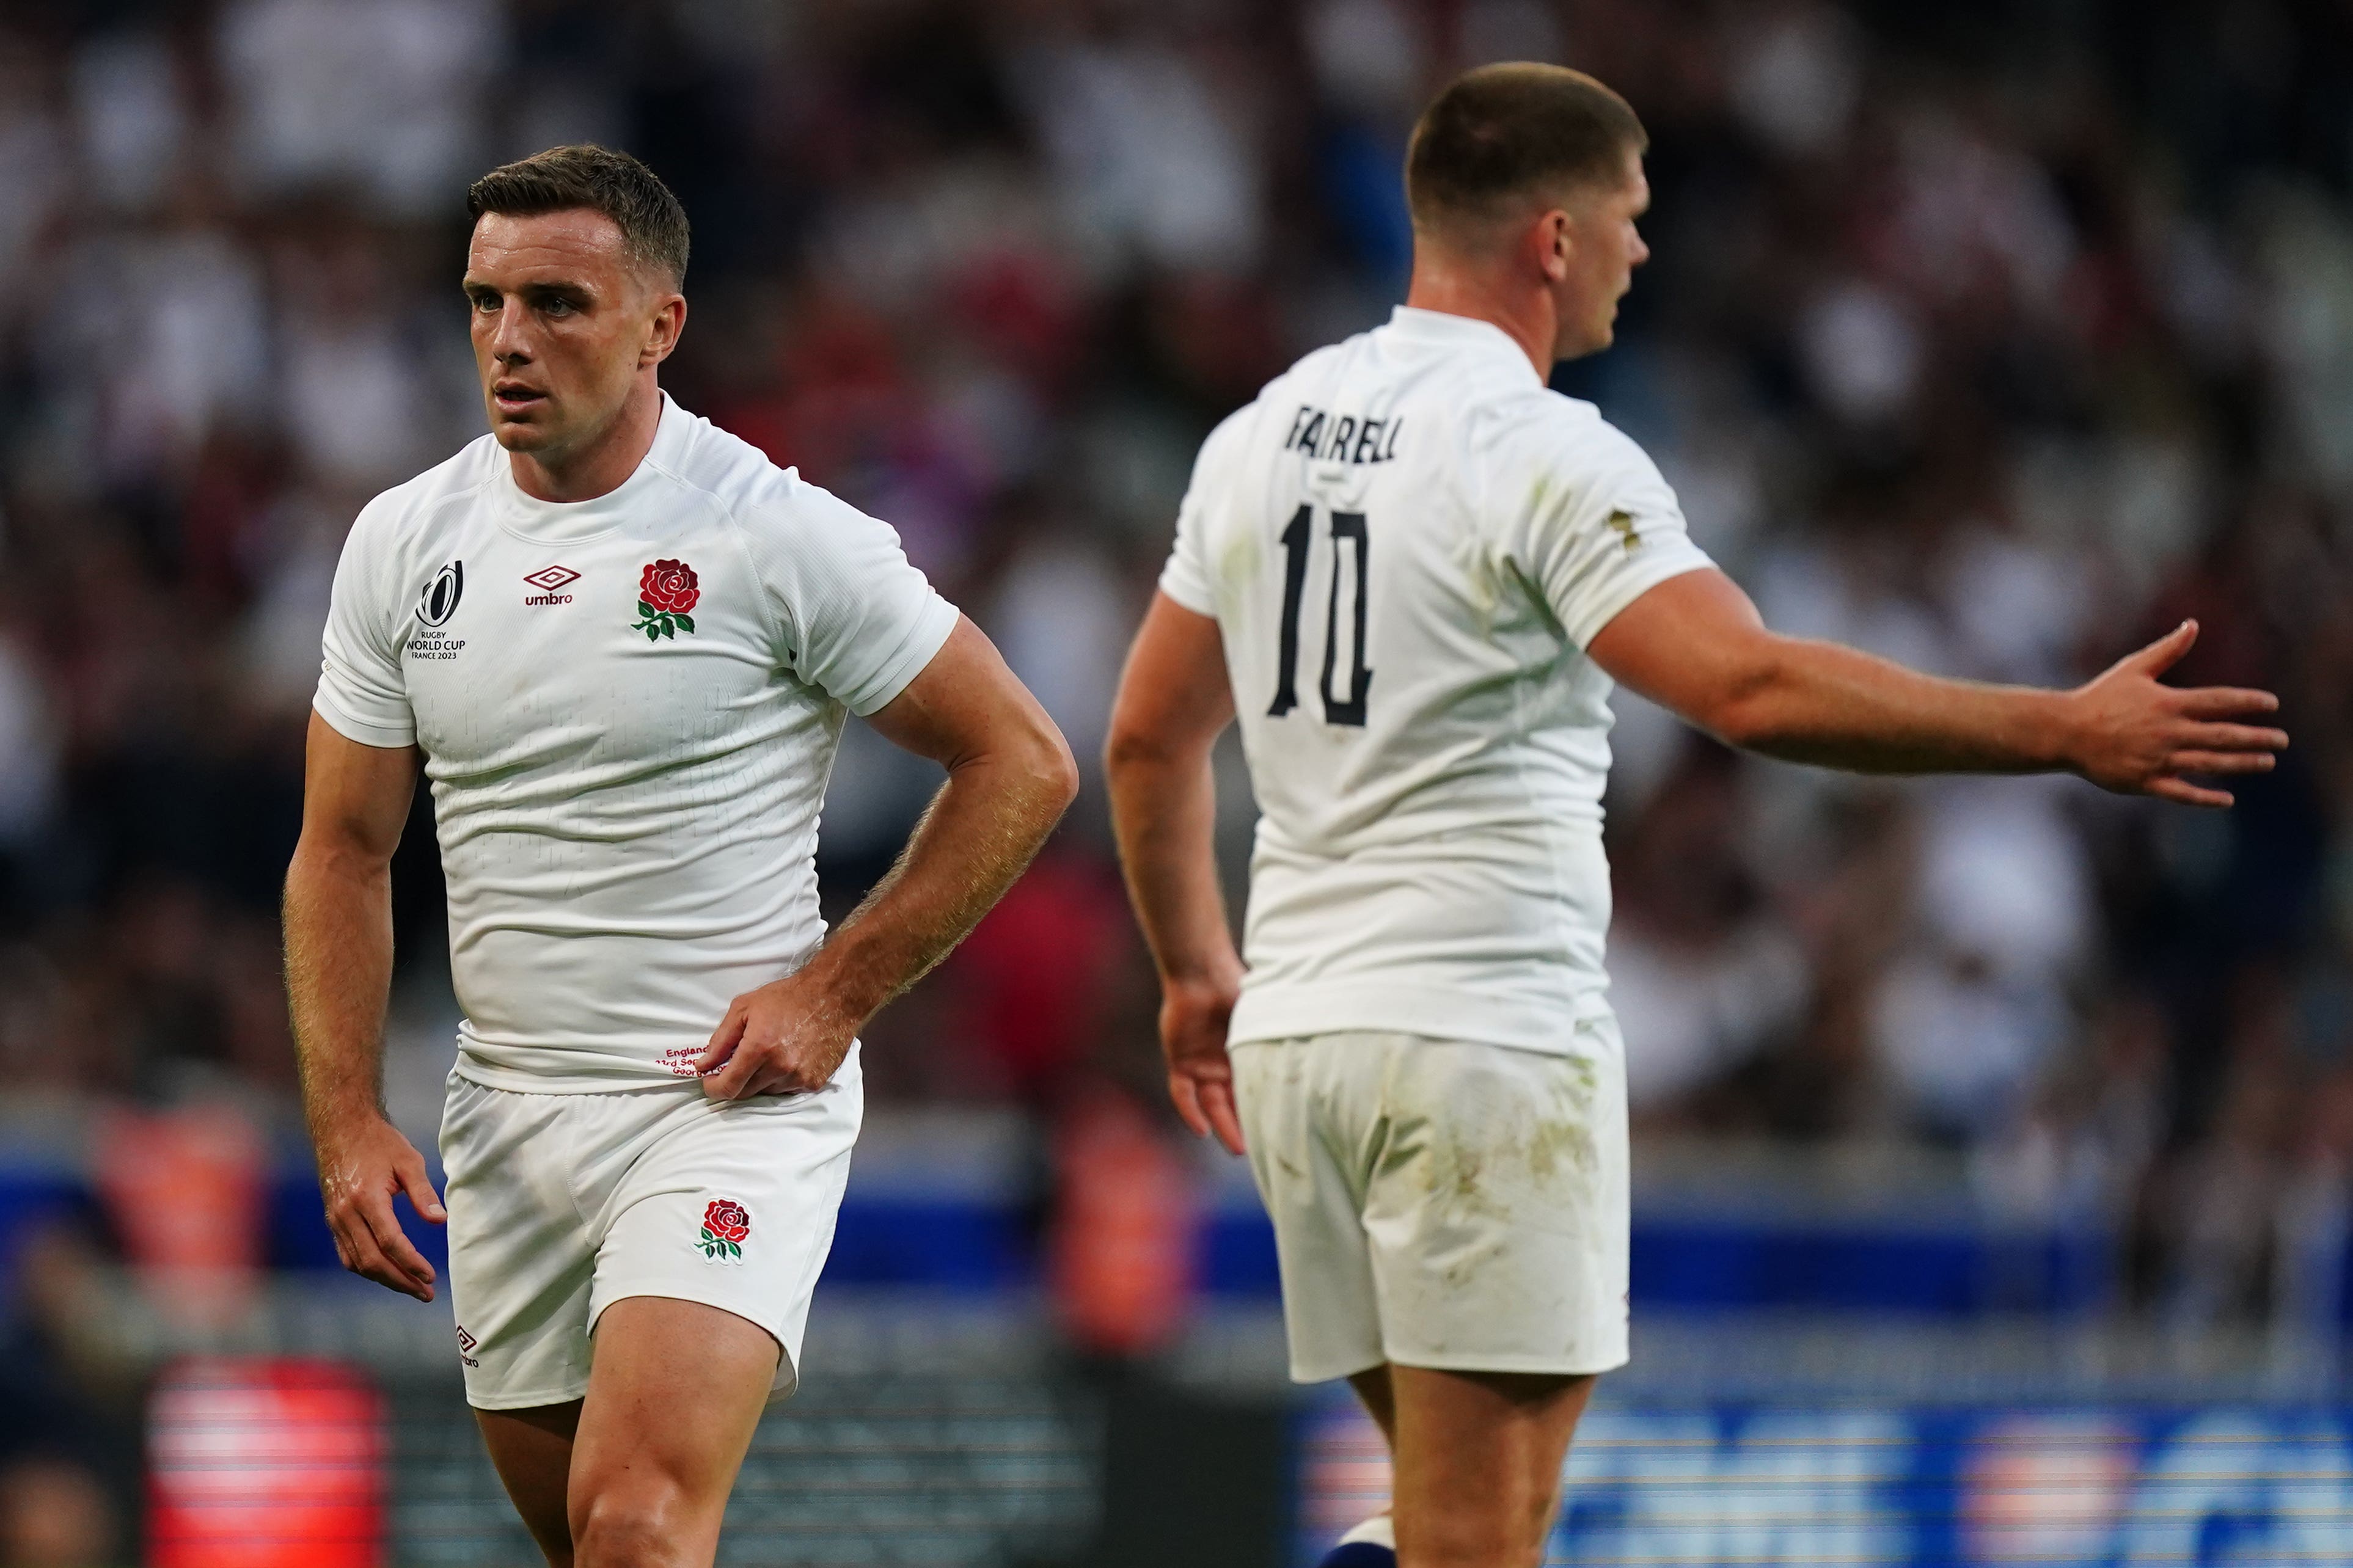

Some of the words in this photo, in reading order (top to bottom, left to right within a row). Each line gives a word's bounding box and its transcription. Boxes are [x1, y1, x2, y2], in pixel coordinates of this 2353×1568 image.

[1286, 404, 1402, 464] FARELL
[525, 593, 573, 605] umbro
[1267, 503, 1374, 727] 10
[407, 640, 441, 650] WORLD
[444, 640, 465, 650] CUP
